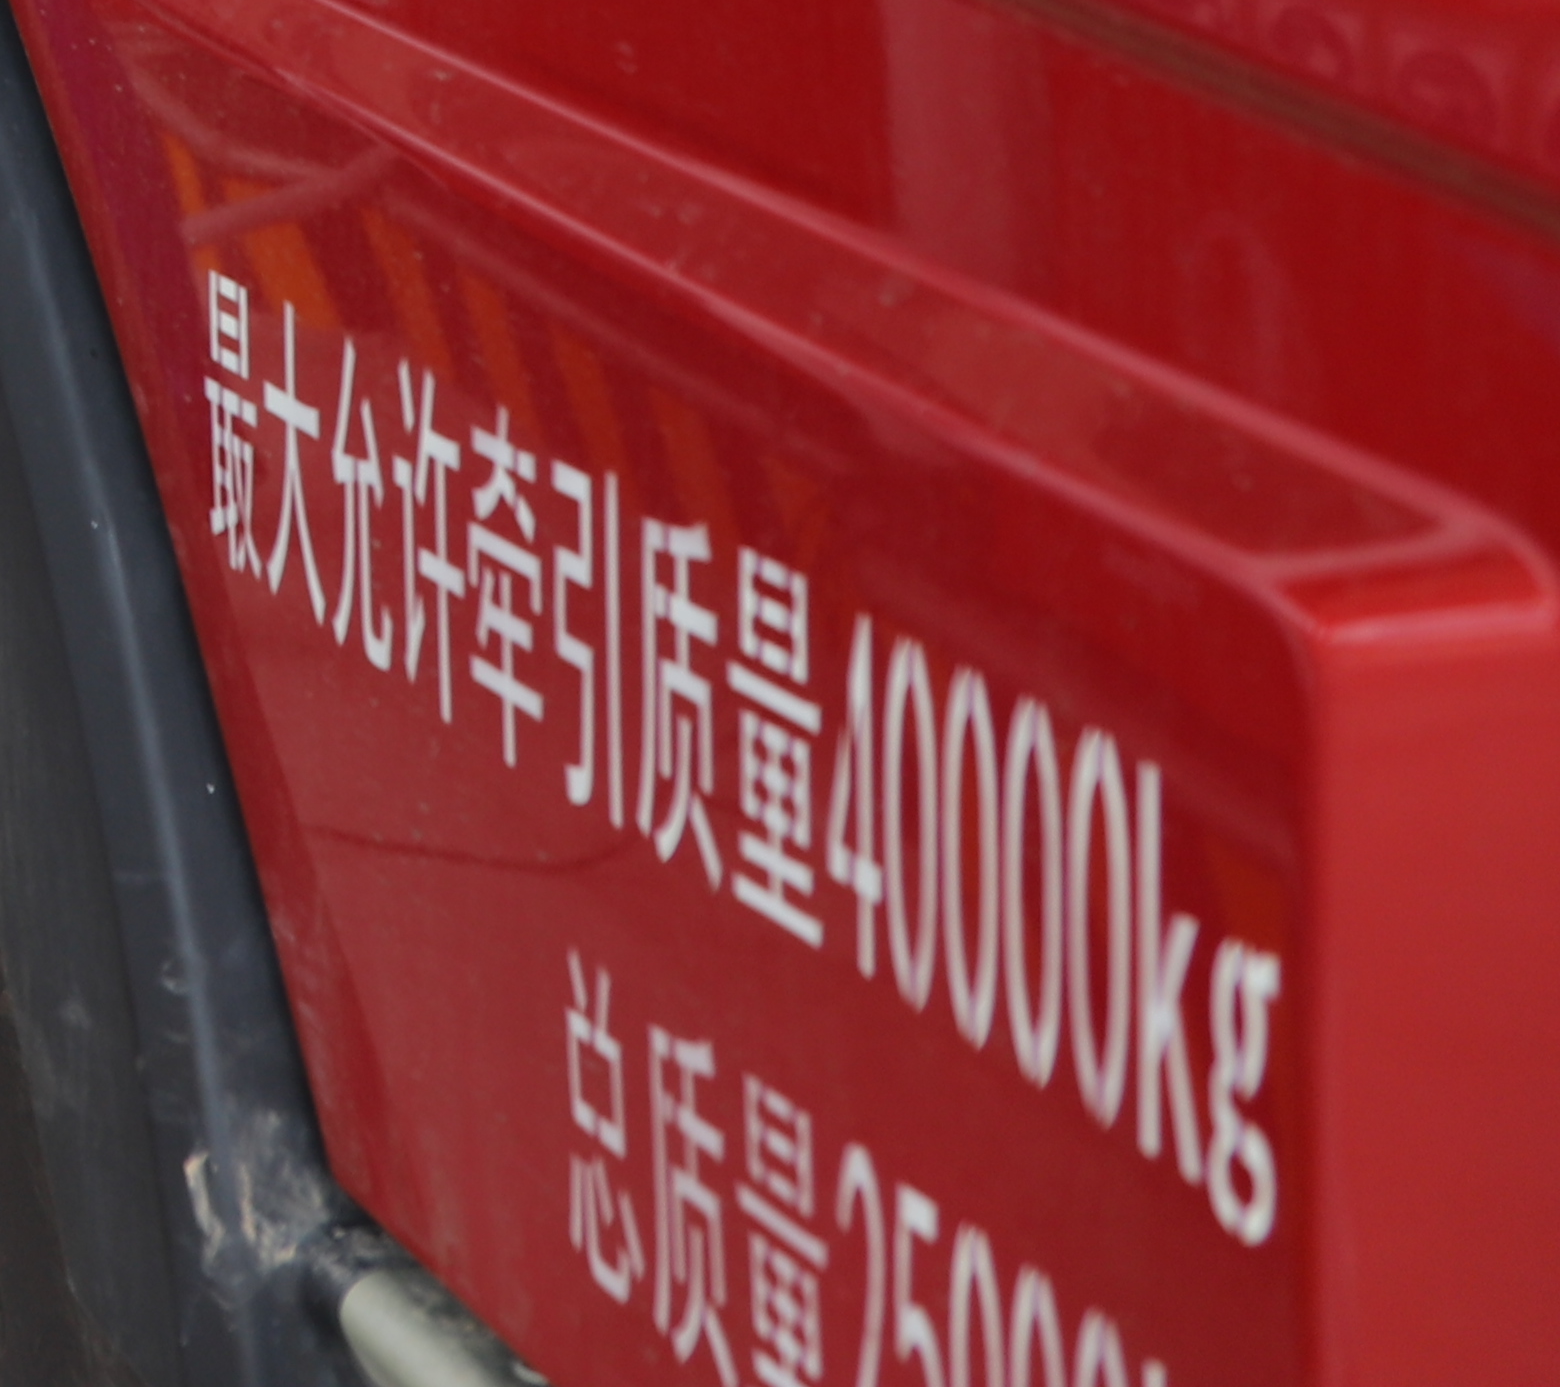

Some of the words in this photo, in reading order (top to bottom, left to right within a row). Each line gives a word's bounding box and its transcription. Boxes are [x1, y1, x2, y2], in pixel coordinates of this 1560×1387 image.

[204, 270, 1282, 1246] 最大允许牵引质量40000kg
[565, 949, 1168, 1387] 总质量25
